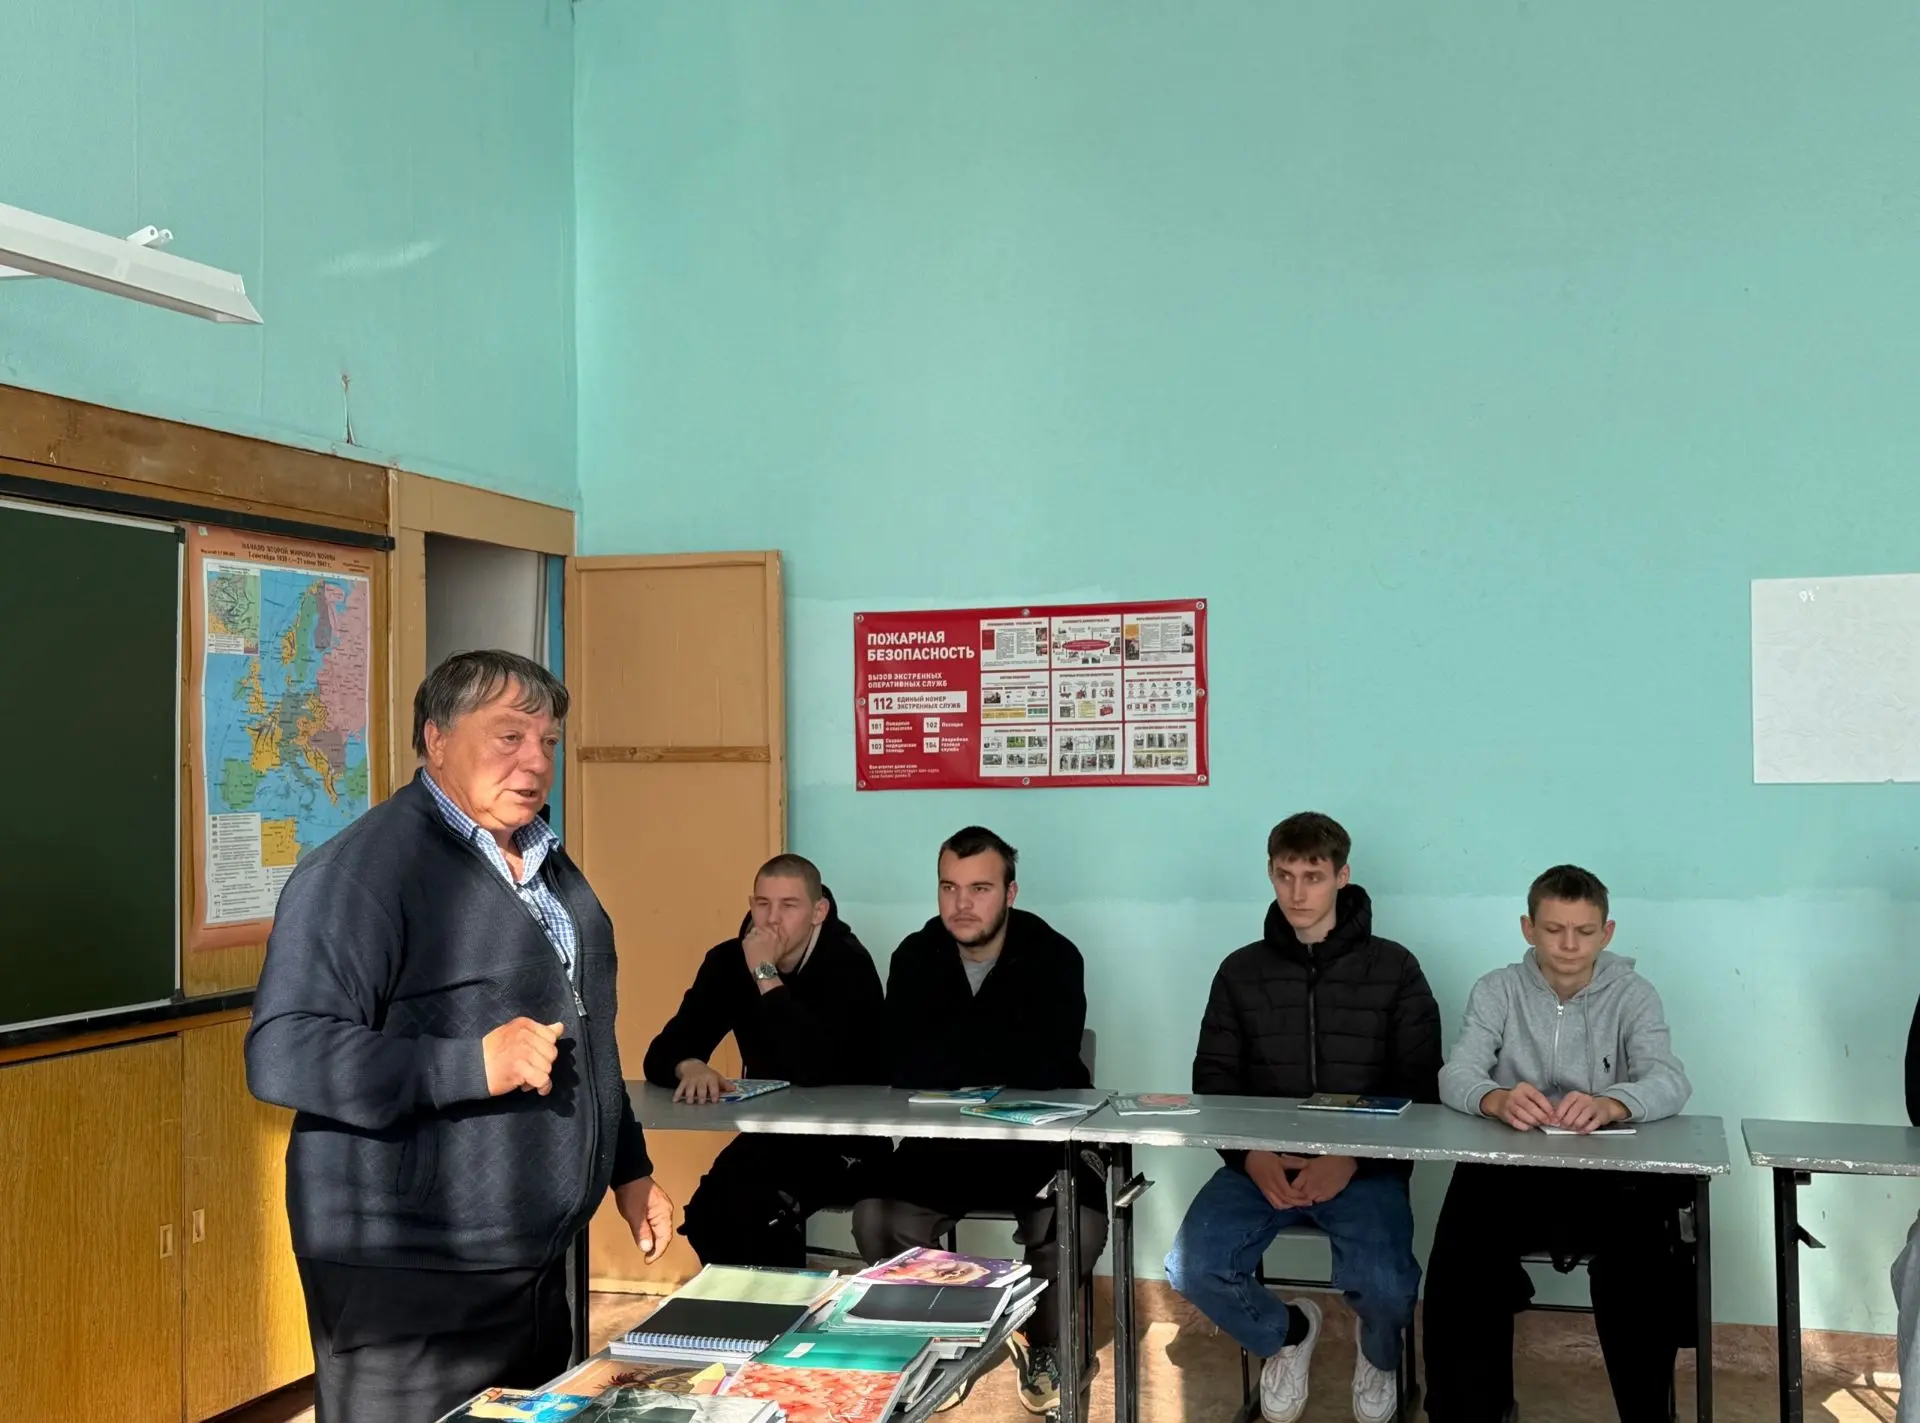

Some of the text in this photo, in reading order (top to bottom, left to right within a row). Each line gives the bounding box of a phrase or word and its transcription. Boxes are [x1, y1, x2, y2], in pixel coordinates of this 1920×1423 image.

[867, 631, 945, 645] ПОЖАРНАЯ
[867, 646, 975, 661] БЕЗОПАСНОСТЬ
[894, 672, 942, 680] ЭКСТРЕННЫХ
[897, 695, 924, 703] ЕДИНЫЙ
[873, 697, 893, 711] 112
[926, 721, 938, 729] 102
[926, 741, 937, 749] 104
